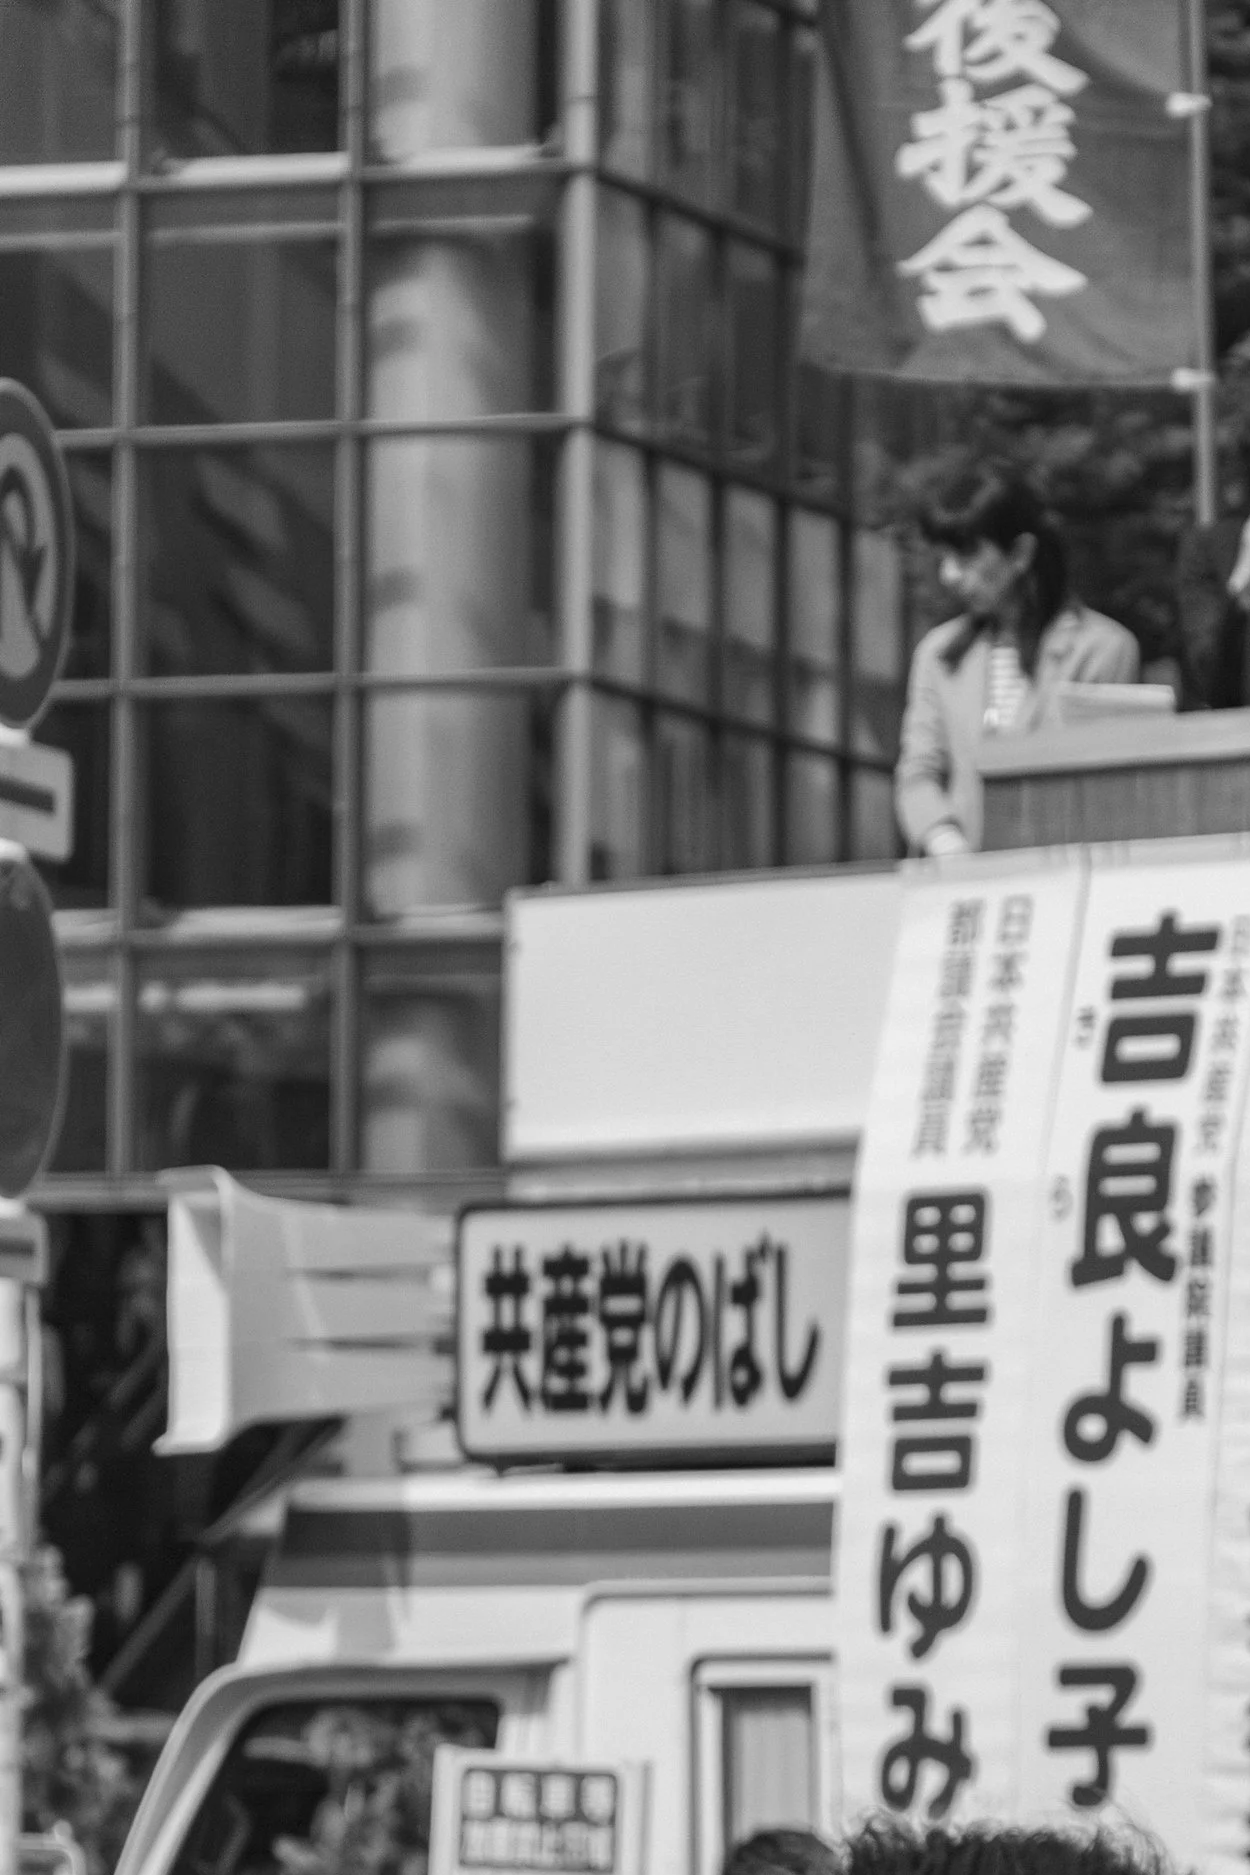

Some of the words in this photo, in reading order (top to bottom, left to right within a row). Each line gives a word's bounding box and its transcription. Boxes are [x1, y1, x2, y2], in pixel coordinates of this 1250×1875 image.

[895, 0, 1094, 344] 後援会
[482, 1228, 822, 1417] 共産党のばし
[874, 1187, 992, 1819] 里吉ゆみ
[1045, 905, 1220, 1808] 吉良よし子
